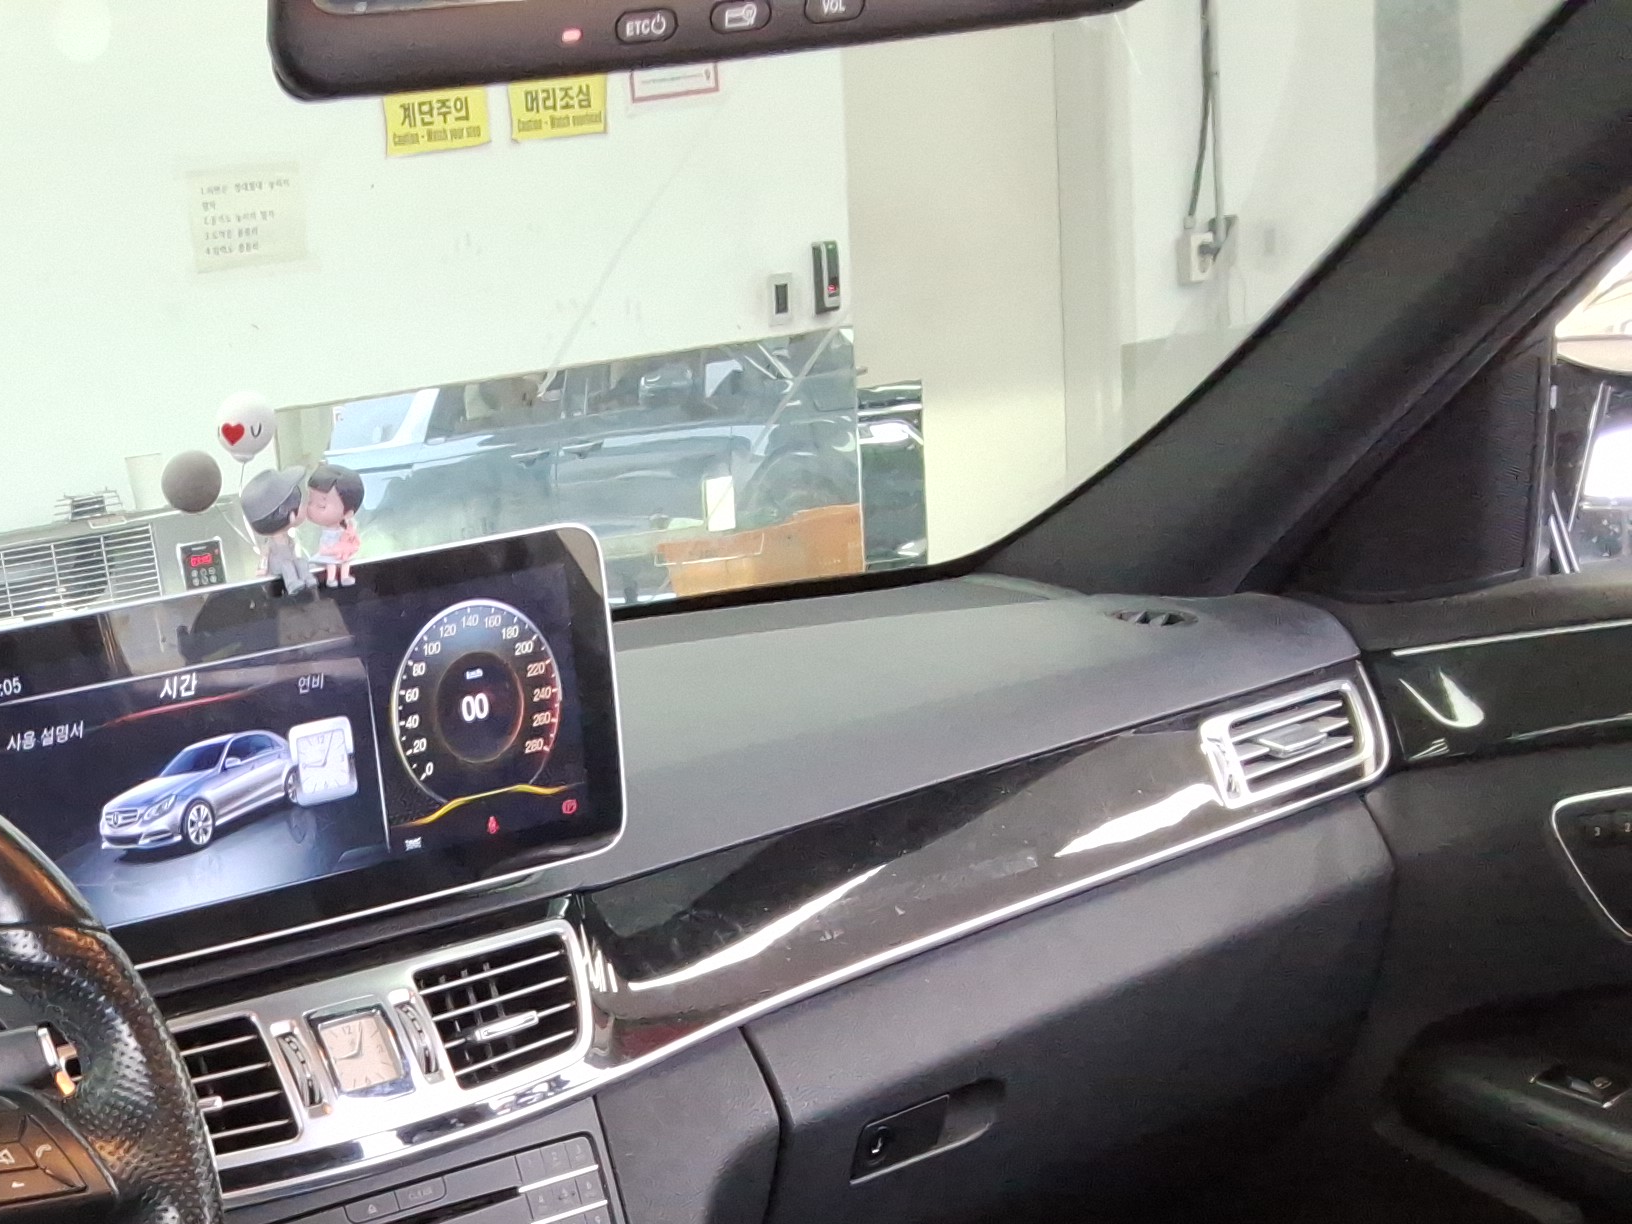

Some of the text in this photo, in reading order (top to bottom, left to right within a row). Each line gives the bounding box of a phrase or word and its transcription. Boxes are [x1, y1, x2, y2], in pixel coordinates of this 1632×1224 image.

[821, 0, 846, 14] VOL
[625, 18, 651, 37] ETC
[524, 84, 591, 113] 머리조심
[400, 96, 470, 128] 계단주의
[250, 422, 262, 438] U
[461, 614, 479, 628] 140
[484, 615, 501, 628] 160
[440, 623, 457, 637] 120
[501, 625, 519, 640] 180
[423, 642, 441, 655] 100
[515, 641, 533, 655] 200
[412, 662, 426, 676] 80
[527, 662, 545, 677] 220
[159, 672, 198, 699] 시간
[298, 673, 325, 694] 연비
[405, 688, 419, 702] 60
[533, 688, 551, 702] 240
[461, 692, 489, 722] 00
[405, 715, 419, 728] 40
[6, 720, 85, 752] 사용 설명서
[413, 738, 427, 752] 20
[425, 762, 434, 776] 0
